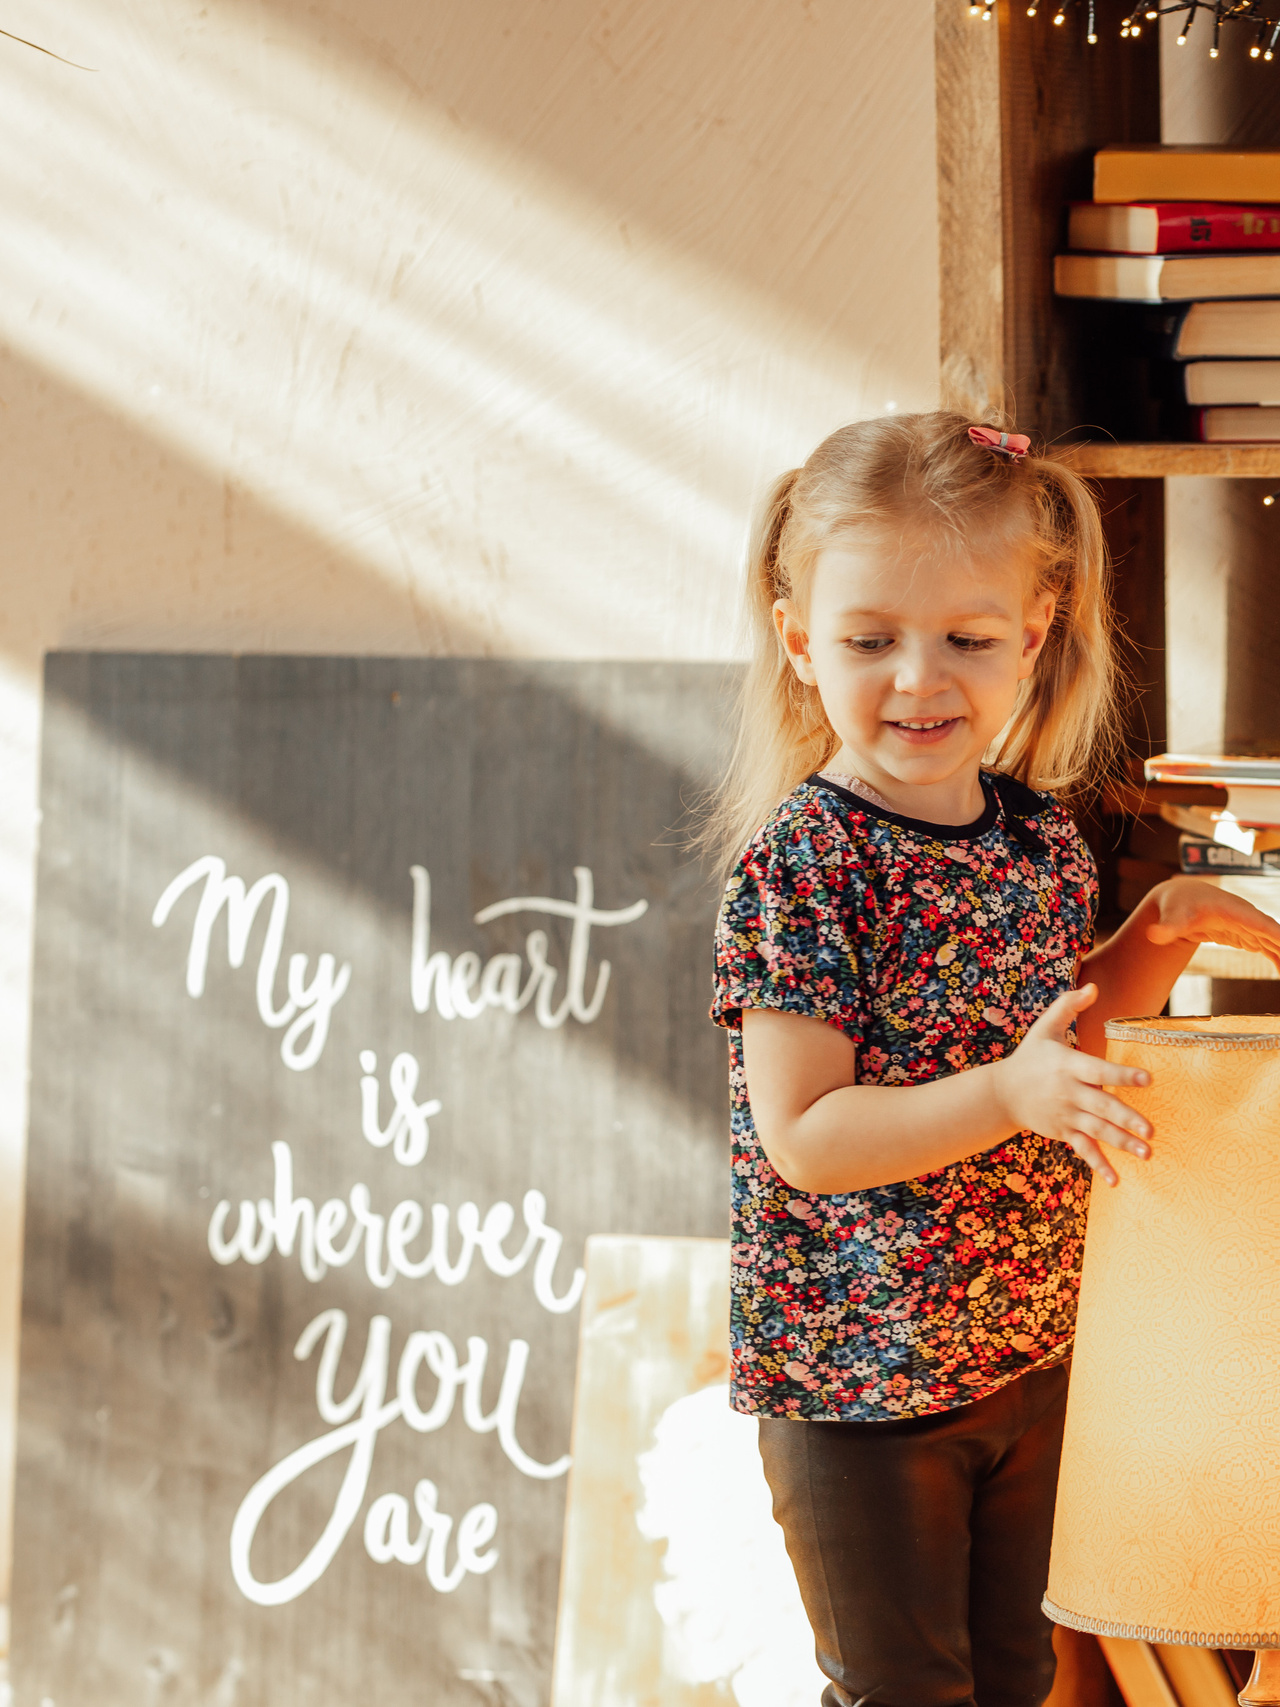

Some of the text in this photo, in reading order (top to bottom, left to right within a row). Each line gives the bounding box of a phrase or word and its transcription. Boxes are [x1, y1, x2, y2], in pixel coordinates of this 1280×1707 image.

[152, 855, 649, 1071] My heart
[359, 1049, 442, 1167] is
[208, 1141, 586, 1313] wherever
[364, 1479, 500, 1593] are
